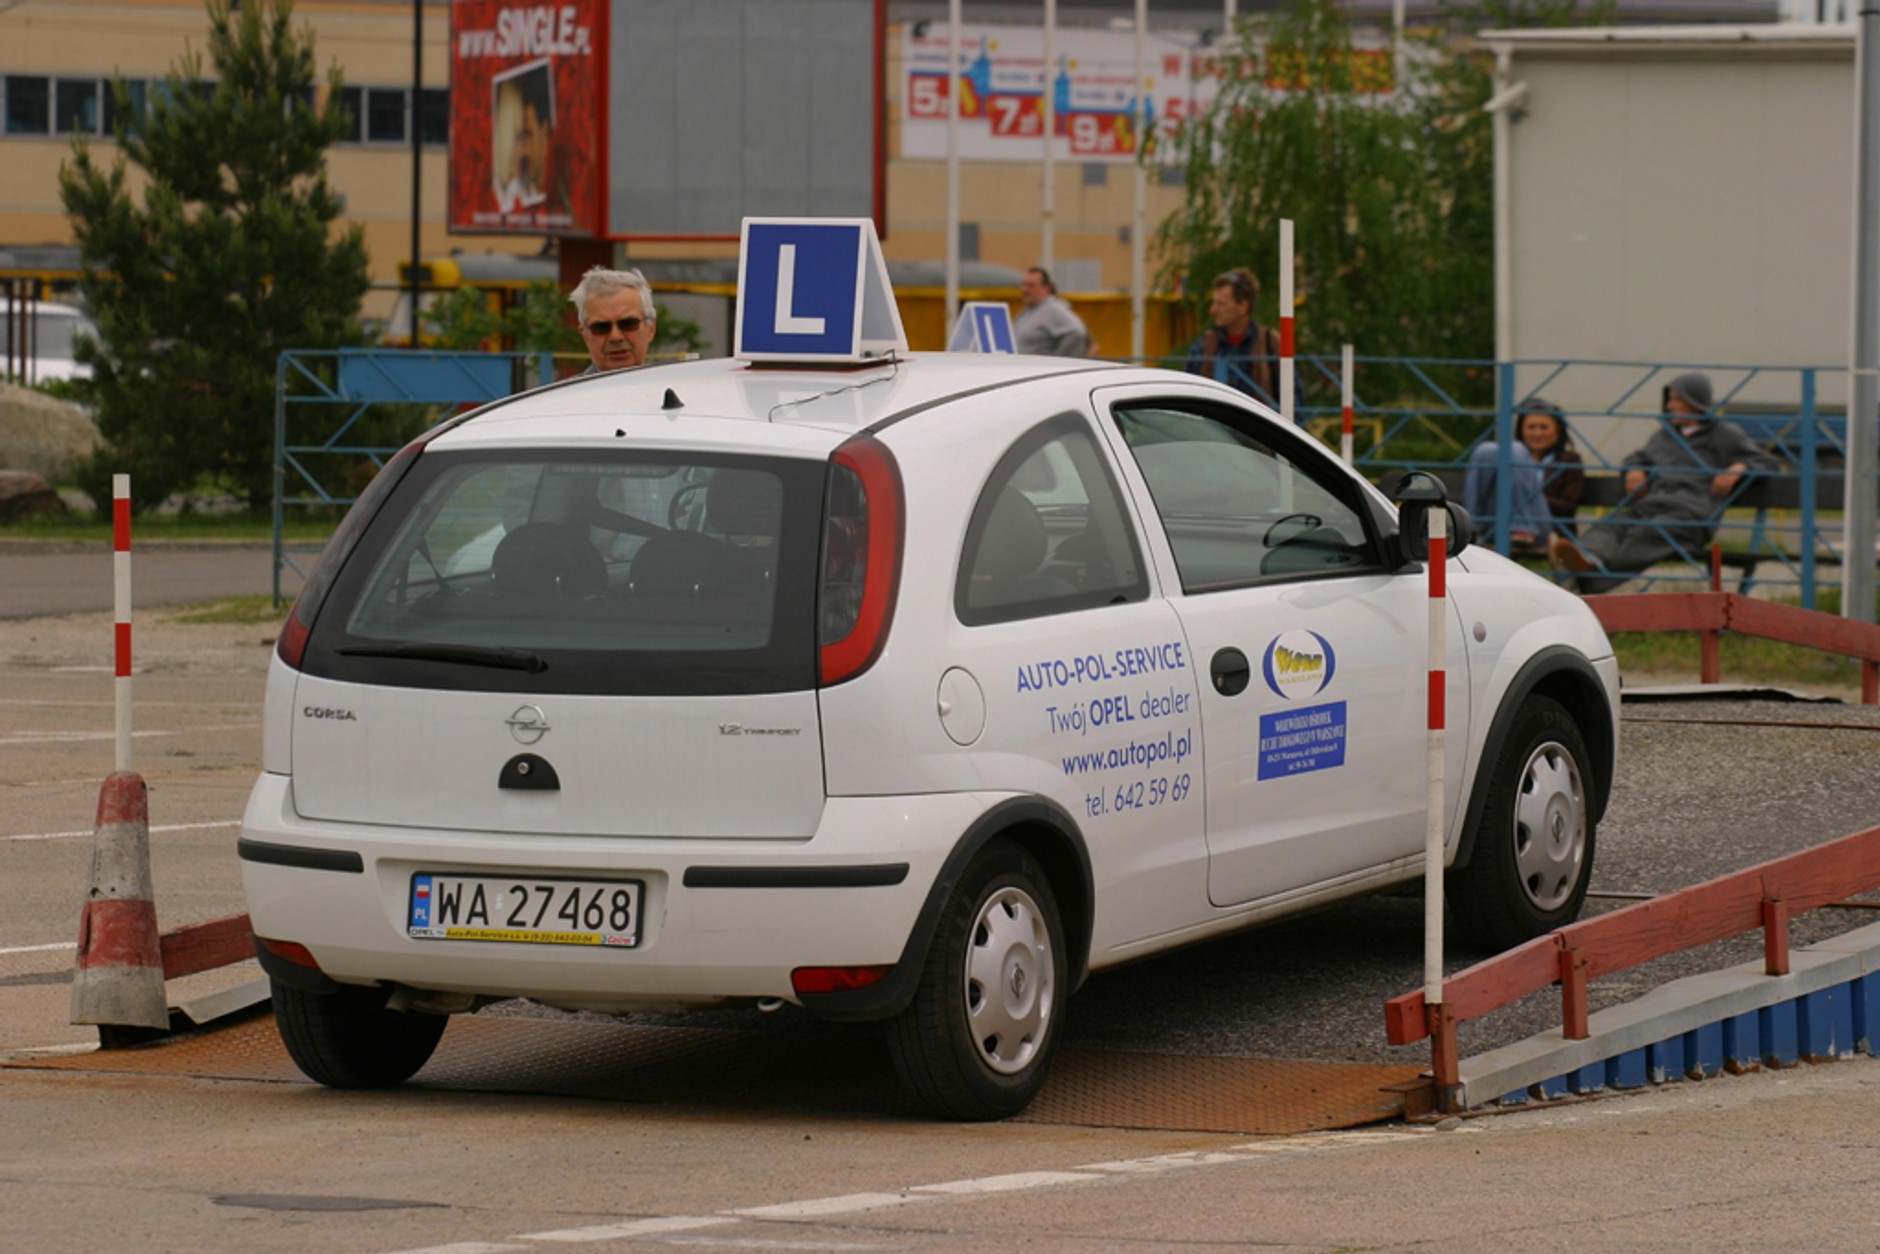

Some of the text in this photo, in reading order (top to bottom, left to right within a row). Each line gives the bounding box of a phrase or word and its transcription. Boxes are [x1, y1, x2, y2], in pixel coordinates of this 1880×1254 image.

[774, 244, 825, 334] L
[1017, 642, 1186, 693] AUTO-POL-SERVICE
[303, 706, 358, 721] CORSA
[1046, 686, 1191, 737] Twój OPEL dealer
[1062, 727, 1191, 775] www.autopol.pl
[1085, 773, 1191, 818] tel. 642 59 69
[414, 908, 428, 920] PL
[438, 882, 631, 932] WA 27468
